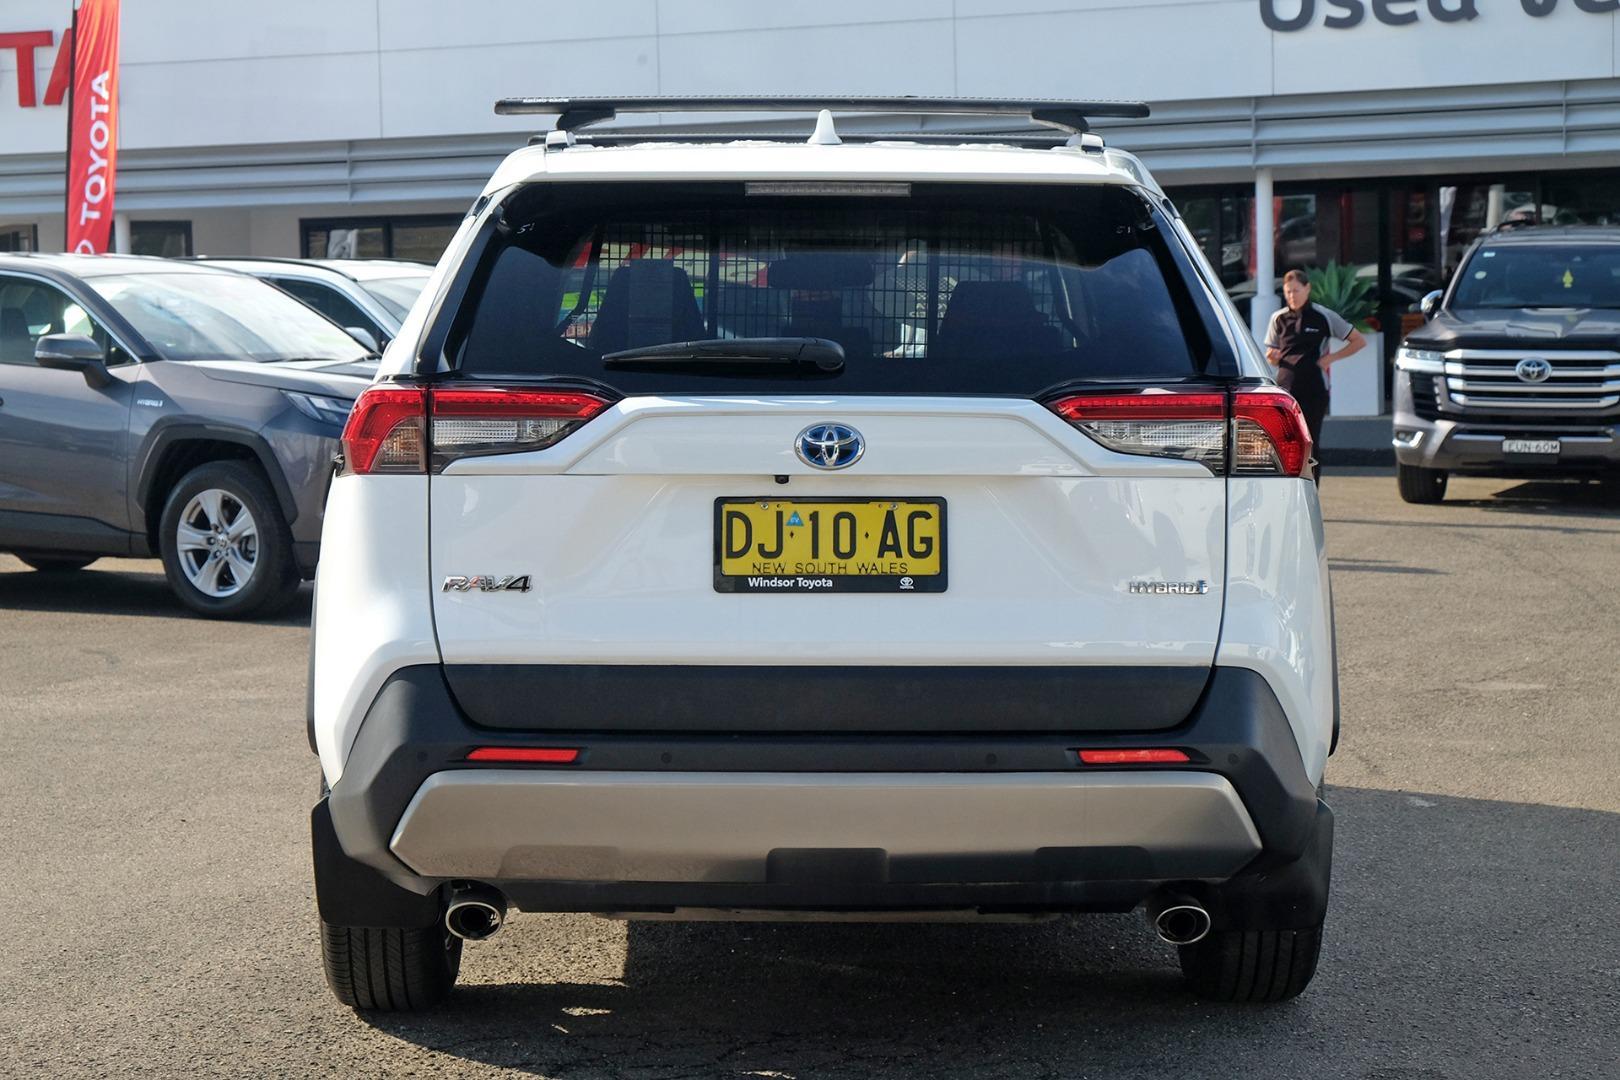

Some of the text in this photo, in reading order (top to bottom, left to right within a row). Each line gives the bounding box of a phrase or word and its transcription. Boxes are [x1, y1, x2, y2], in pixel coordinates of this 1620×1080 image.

[79, 70, 110, 227] TOYOTA
[725, 510, 933, 560] DJ 10 AG
[752, 562, 908, 574] NEW SOUTH WALES
[442, 575, 533, 593] RAV4
[747, 577, 833, 590] Windsor Toyota
[1129, 581, 1197, 594] HYBRID
